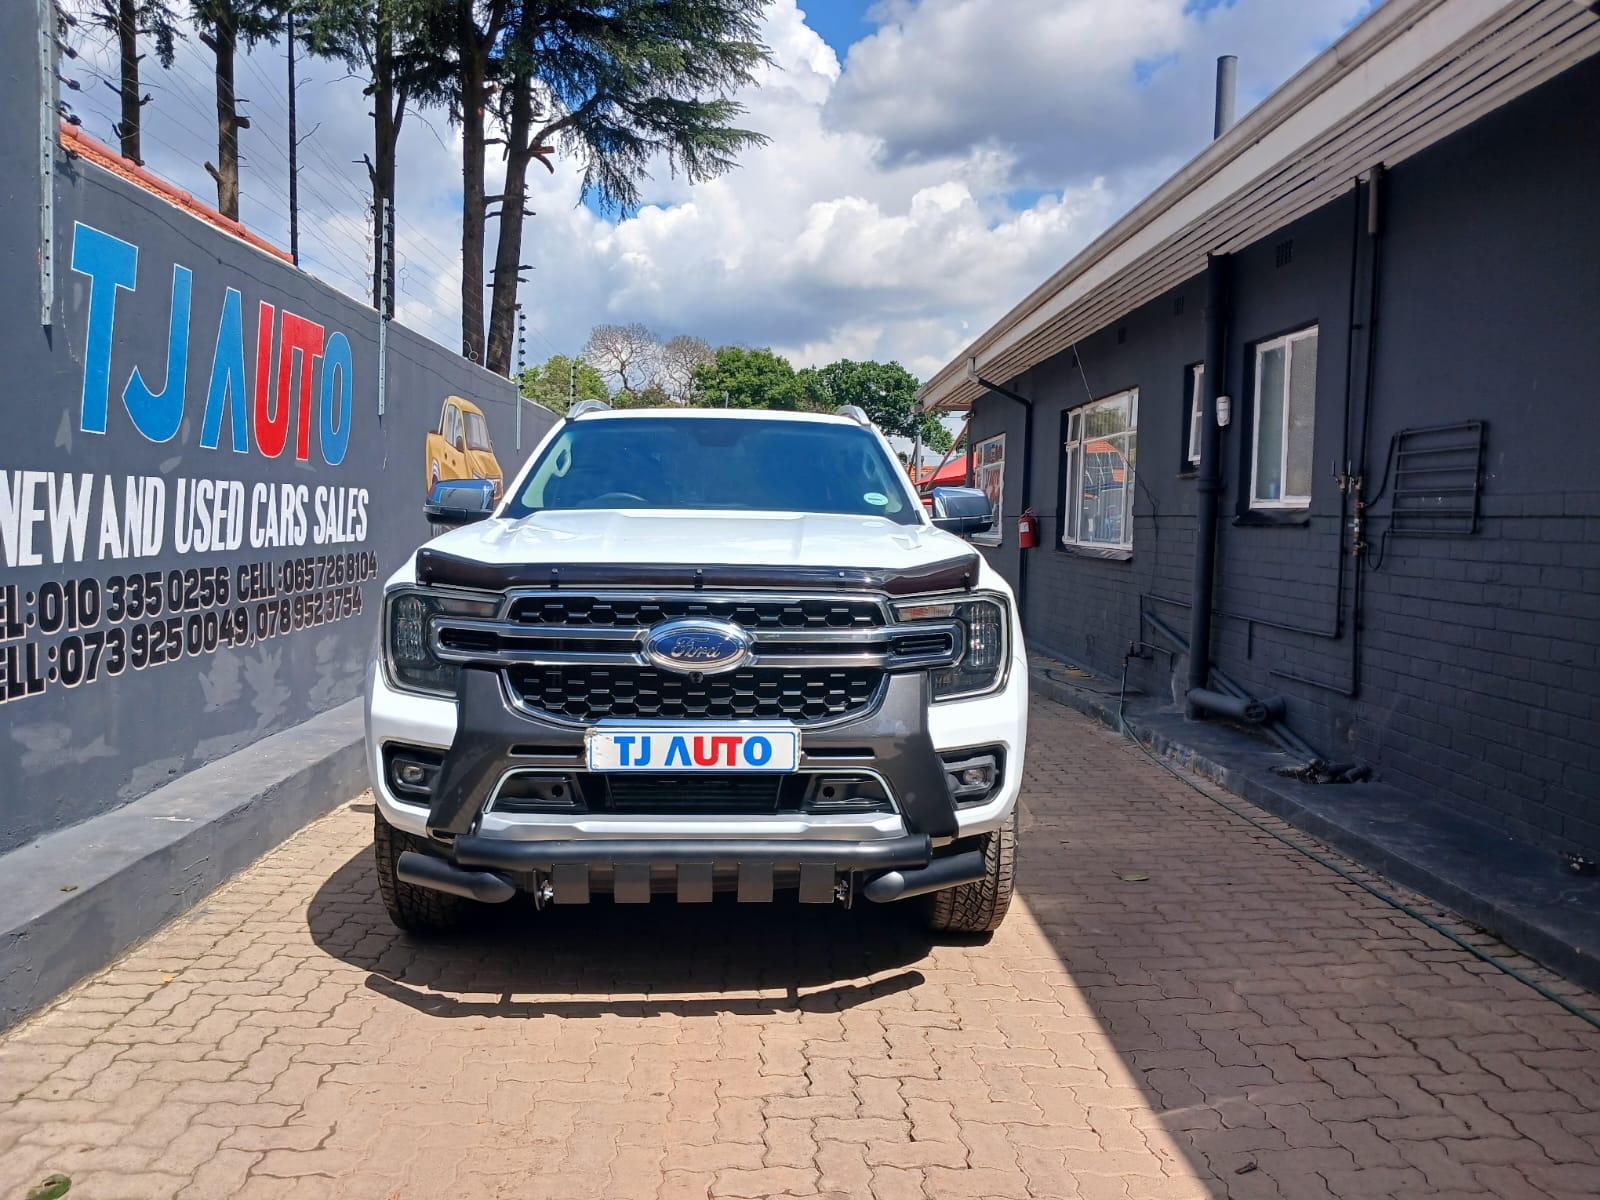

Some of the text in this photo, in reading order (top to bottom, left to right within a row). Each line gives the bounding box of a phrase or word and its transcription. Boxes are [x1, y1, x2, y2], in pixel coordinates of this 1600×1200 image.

[71, 220, 353, 466] TJ AUTO
[0, 470, 369, 567] NEW AND USED CARS SALES
[106, 571, 164, 624] 335
[167, 566, 231, 614] 0256
[316, 553, 344, 590] 726
[346, 550, 379, 584] 8104
[131, 616, 184, 671] 925
[293, 592, 325, 632] 952
[325, 585, 363, 623] 3754
[670, 636, 723, 659] Ford
[613, 735, 773, 767] TJ AUTO
